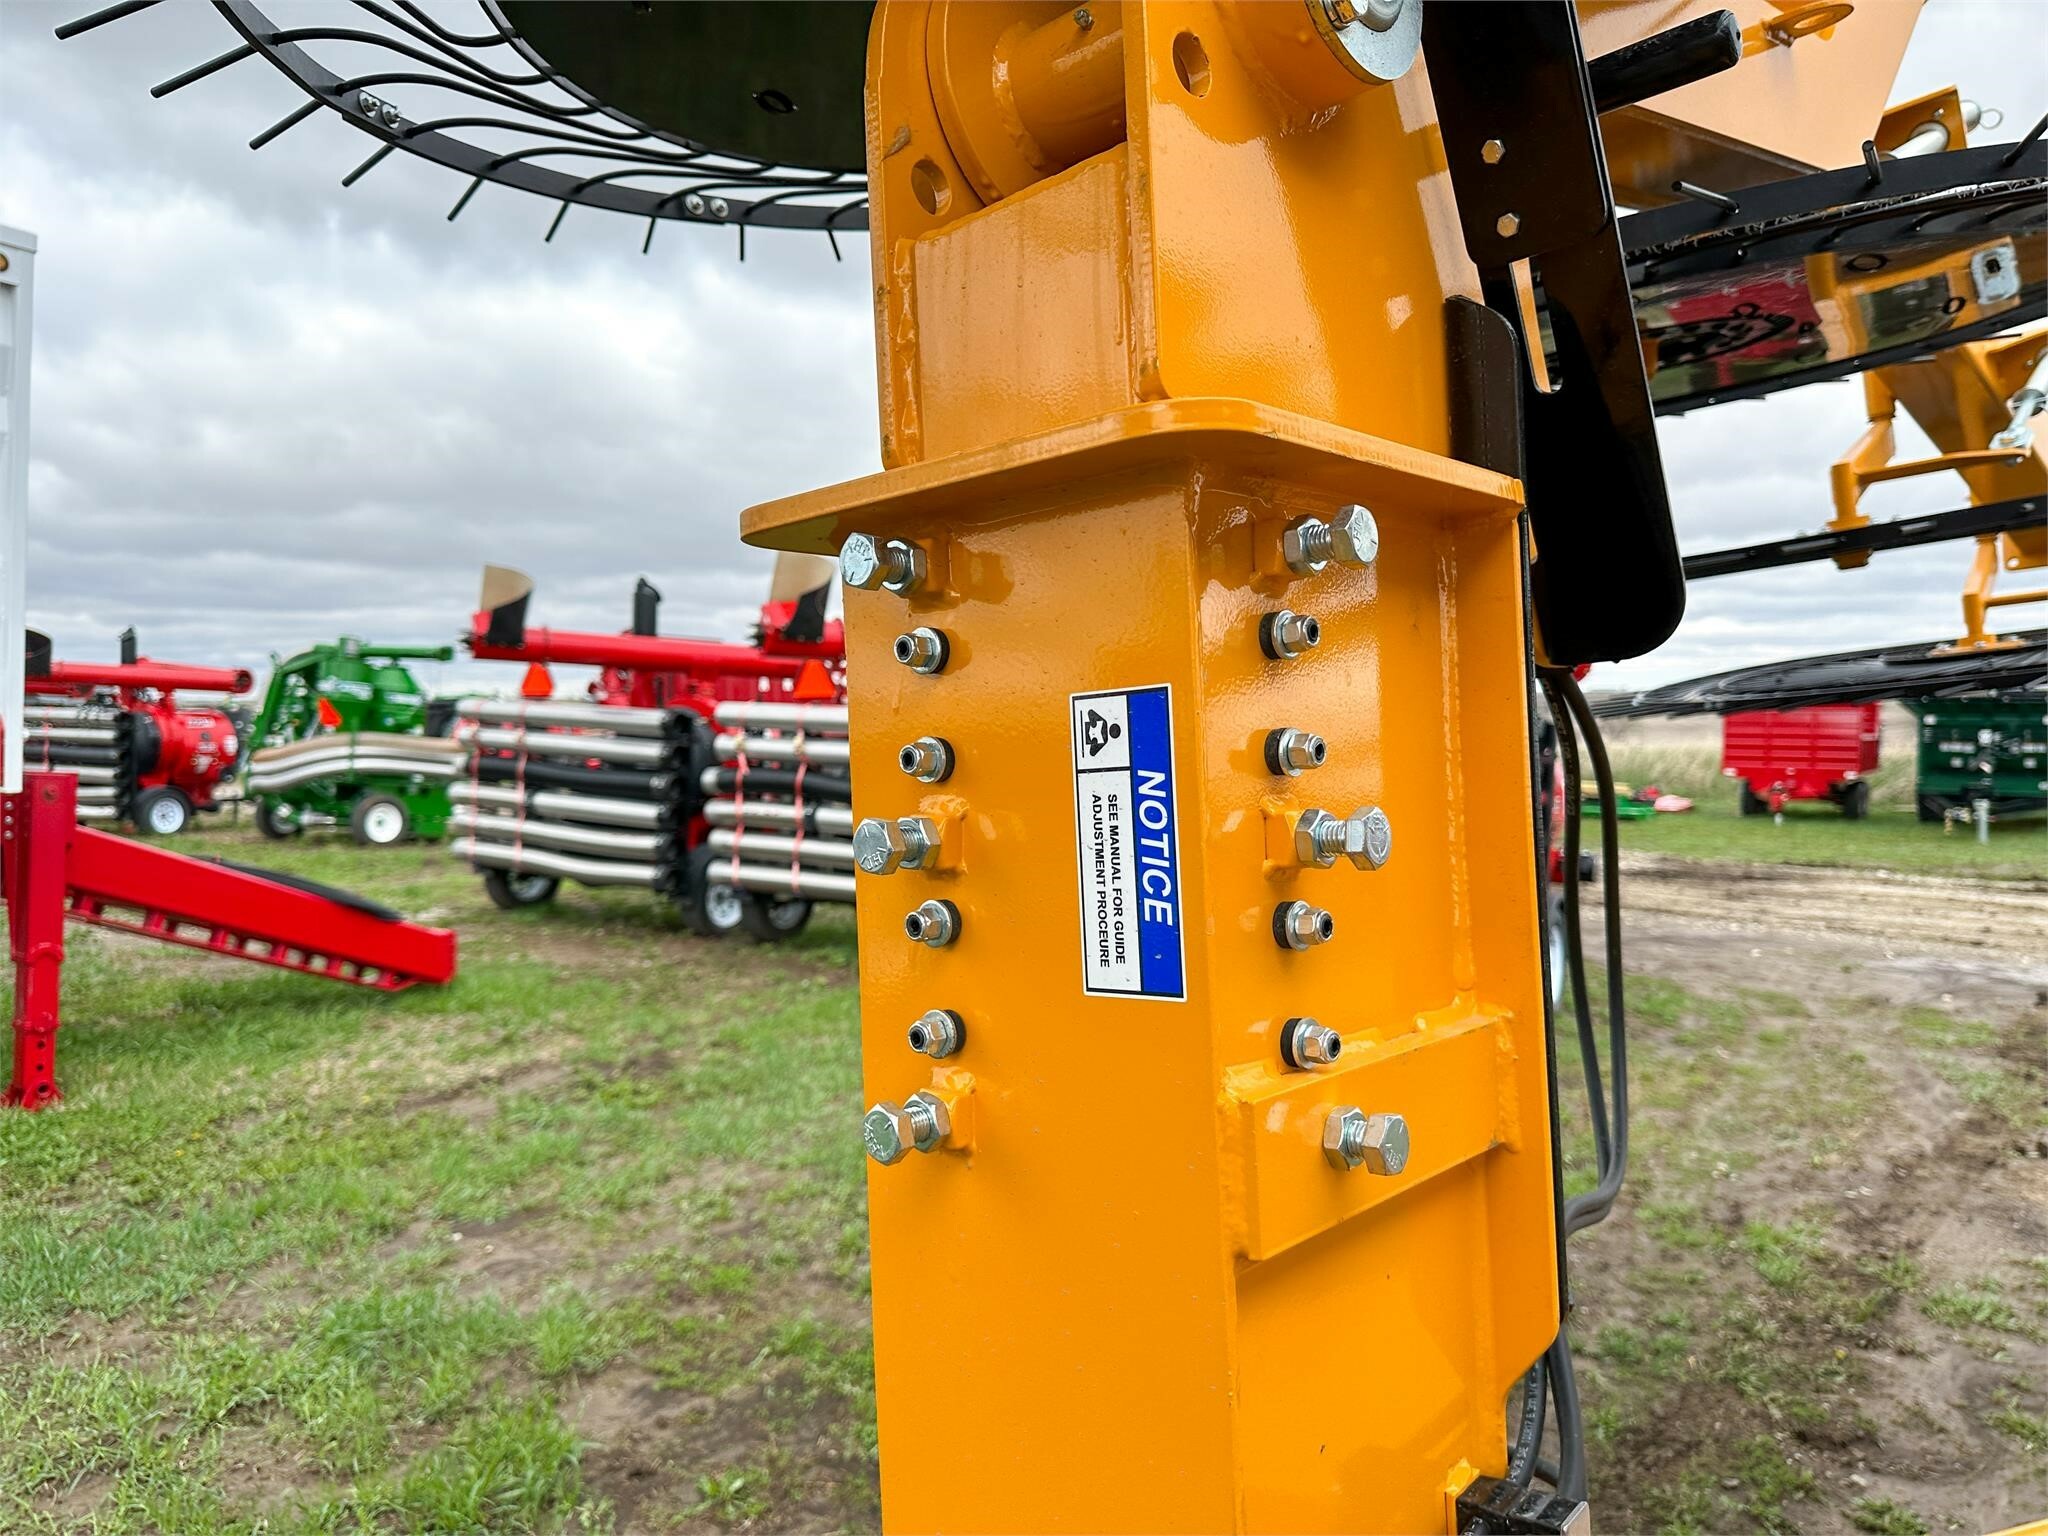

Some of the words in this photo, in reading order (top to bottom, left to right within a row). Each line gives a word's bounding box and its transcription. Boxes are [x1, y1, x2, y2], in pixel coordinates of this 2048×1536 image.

[1107, 794, 1119, 821] SEE
[1092, 794, 1106, 887] ADJUSTMENT
[1109, 825, 1121, 885] MANUAL
[1137, 769, 1173, 926] NOTICE
[1096, 890, 1110, 968] PROCEURE
[1112, 888, 1123, 917] FOR
[1114, 920, 1126, 965] GUIDE
